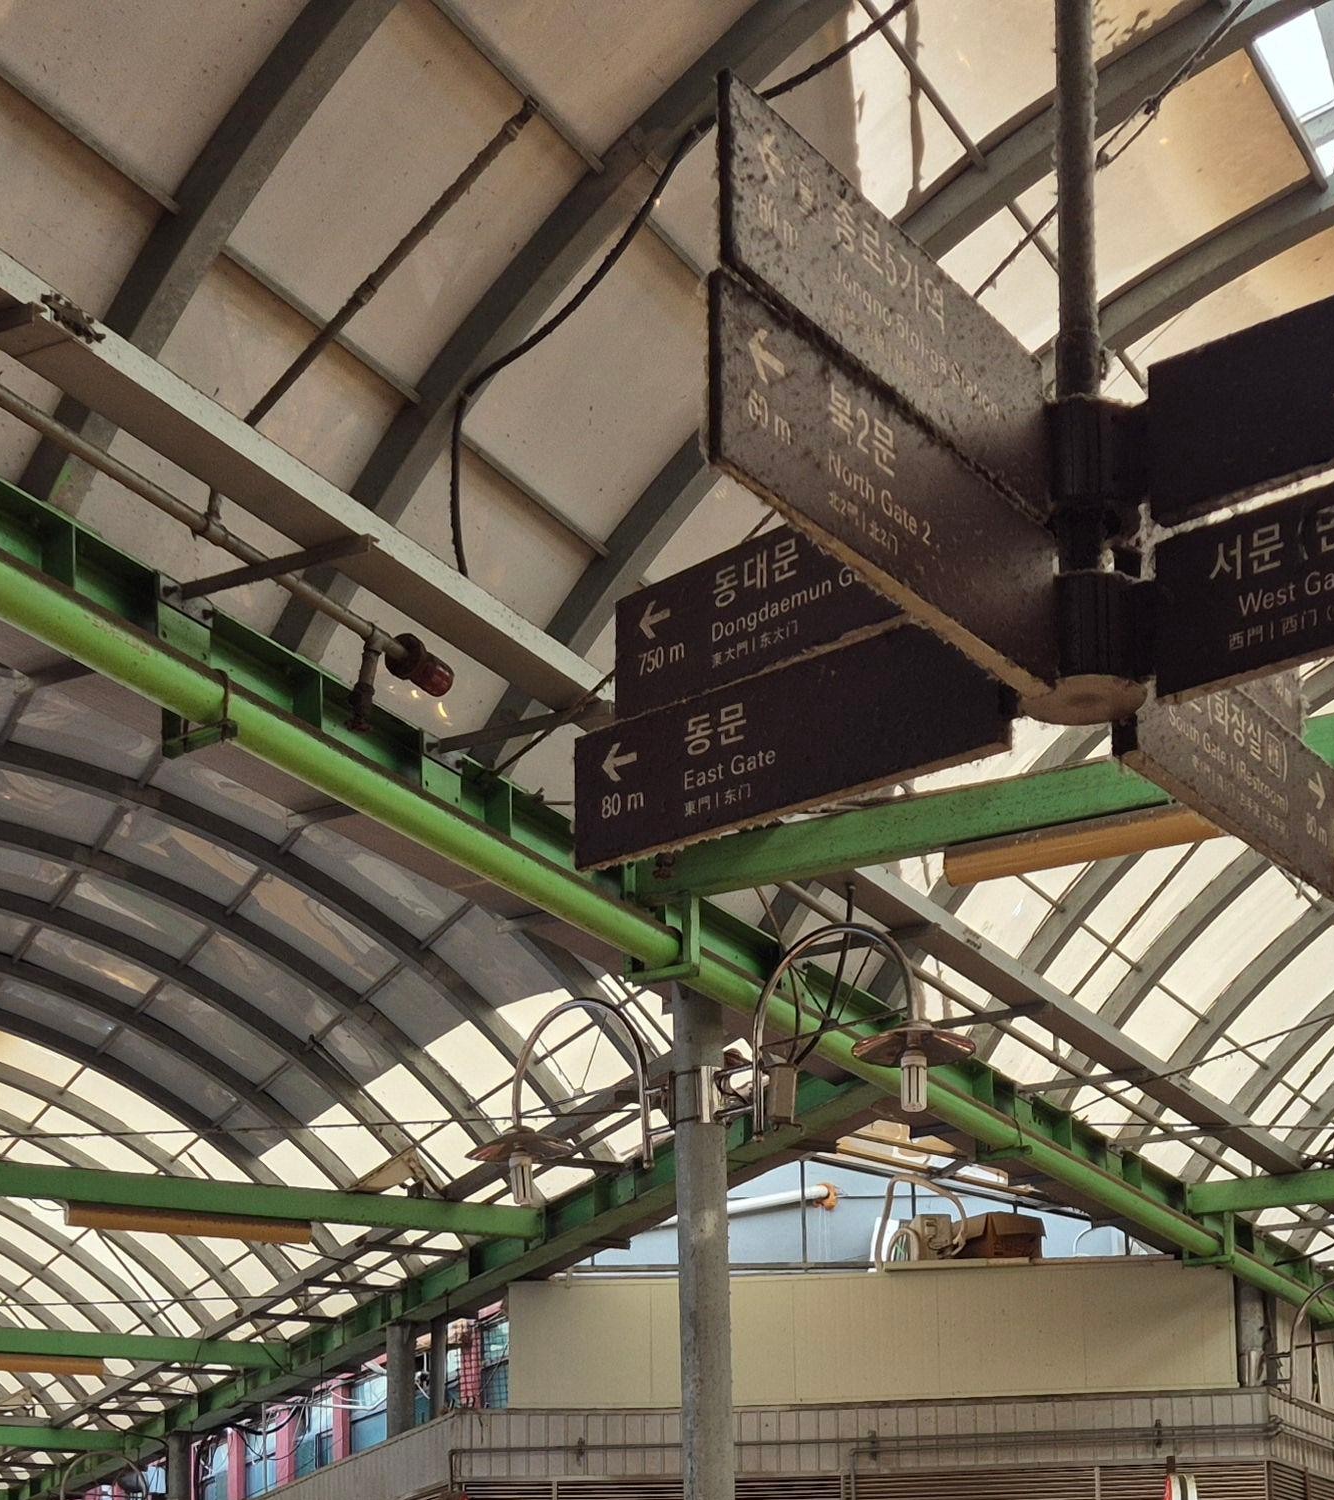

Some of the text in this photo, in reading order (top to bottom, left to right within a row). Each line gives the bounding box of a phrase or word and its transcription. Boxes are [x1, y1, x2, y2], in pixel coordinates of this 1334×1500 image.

[832, 200, 945, 335] 종로5가역
[832, 261, 892, 325] Jongno
[951, 362, 1000, 420] Station
[774, 415, 792, 446] m
[828, 382, 896, 478] 북2문
[828, 450, 931, 546] North Gate 2
[711, 537, 800, 610] 동대문
[1208, 522, 1284, 583] 서문
[711, 577, 832, 643] Dongdaemun
[1238, 583, 1297, 618] West
[638, 640, 685, 676] 750 m
[683, 702, 747, 758] 동문
[1168, 705, 1200, 744] South
[1202, 731, 1228, 766] Gate
[684, 748, 777, 792] East Gate
[601, 789, 645, 821] 80 m
